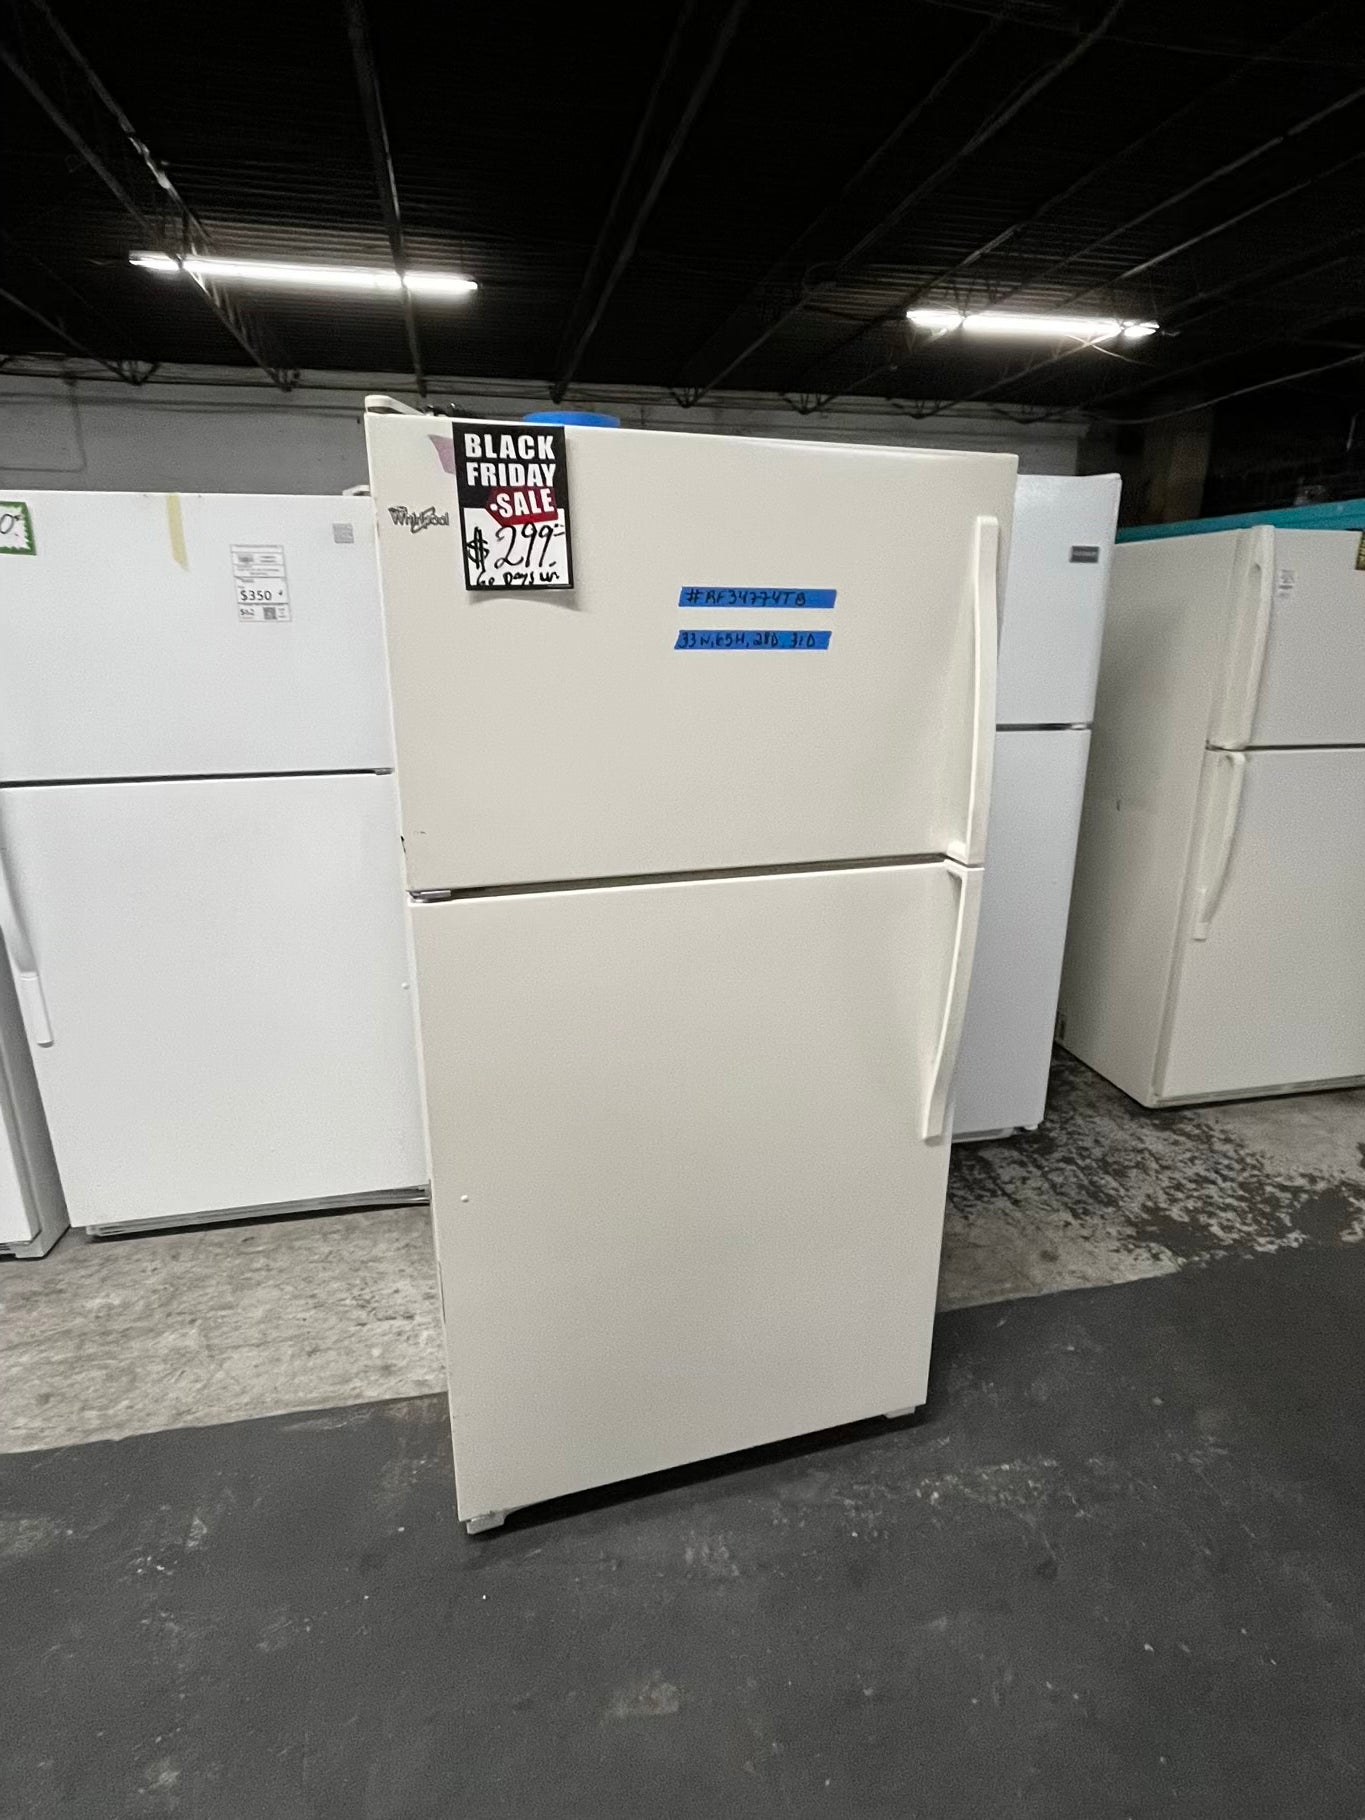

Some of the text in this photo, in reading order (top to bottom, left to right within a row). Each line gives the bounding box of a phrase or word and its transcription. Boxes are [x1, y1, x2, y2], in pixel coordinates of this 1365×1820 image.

[464, 433, 555, 459] BLACK
[466, 462, 556, 487] FRIDAY
[496, 488, 554, 518] SALE
[240, 590, 272, 601] $350
